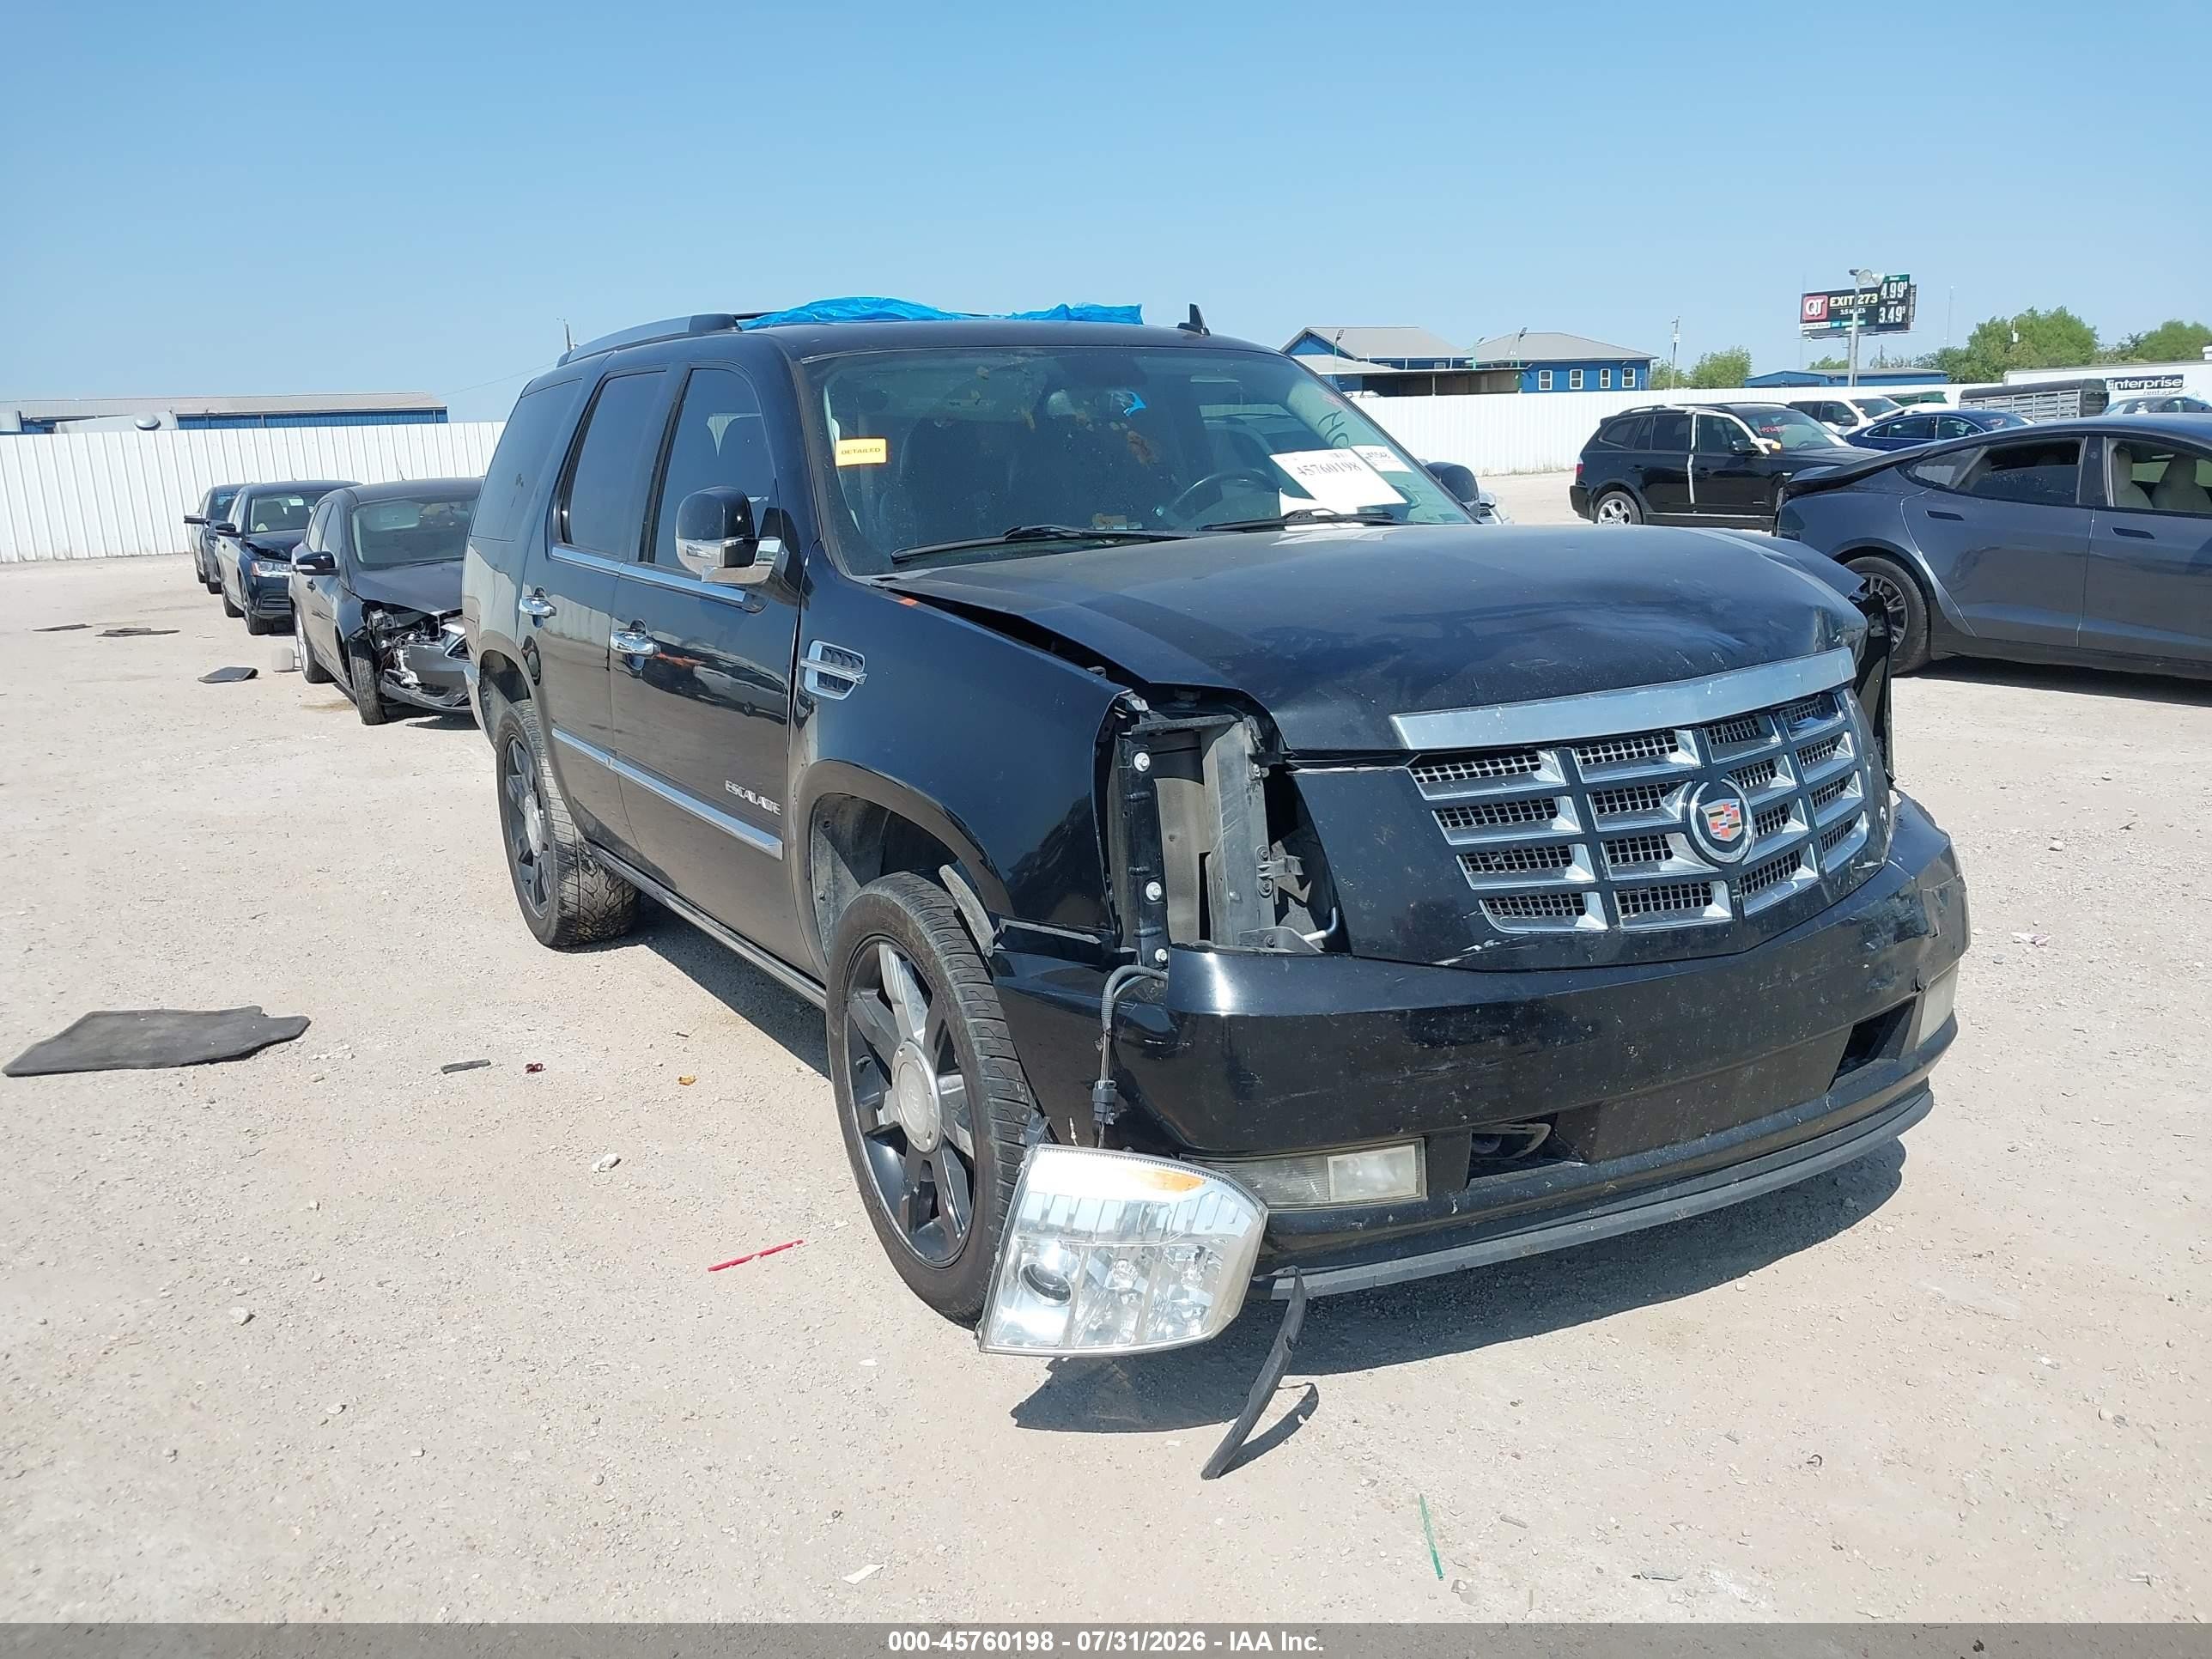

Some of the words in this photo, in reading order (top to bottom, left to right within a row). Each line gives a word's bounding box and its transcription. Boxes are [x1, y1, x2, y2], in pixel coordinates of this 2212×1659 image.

[1805, 299, 1826, 317] QT
[1829, 295, 1855, 307] EXIT
[1857, 293, 1878, 305] 273
[2106, 376, 2183, 392] Enterprise
[725, 780, 781, 816] ESCALADE
